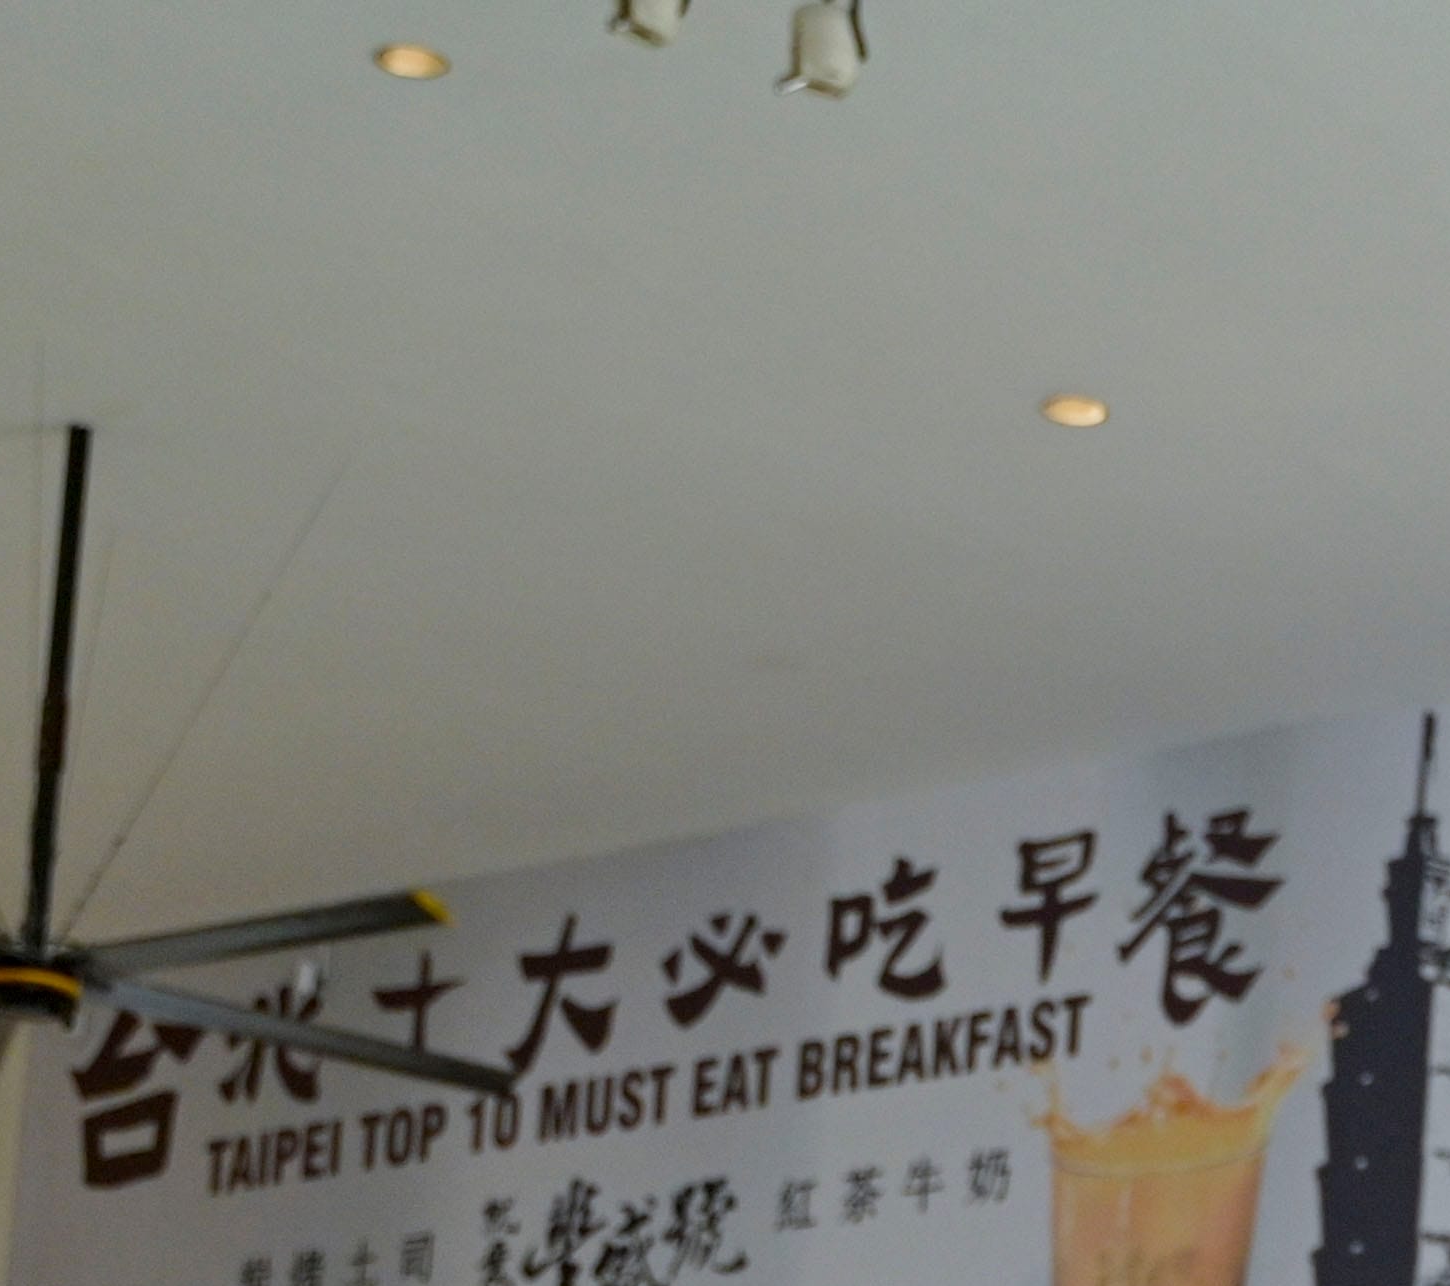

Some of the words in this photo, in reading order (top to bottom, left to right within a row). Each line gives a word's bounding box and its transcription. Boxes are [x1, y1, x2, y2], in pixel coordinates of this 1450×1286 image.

[207, 1120, 342, 1197] TAIPEI
[360, 1104, 446, 1171] TOP
[466, 1091, 520, 1153] 10
[538, 1073, 677, 1143] MUST
[693, 1050, 779, 1114] EAT
[798, 996, 1091, 1096] BREAKFAST
